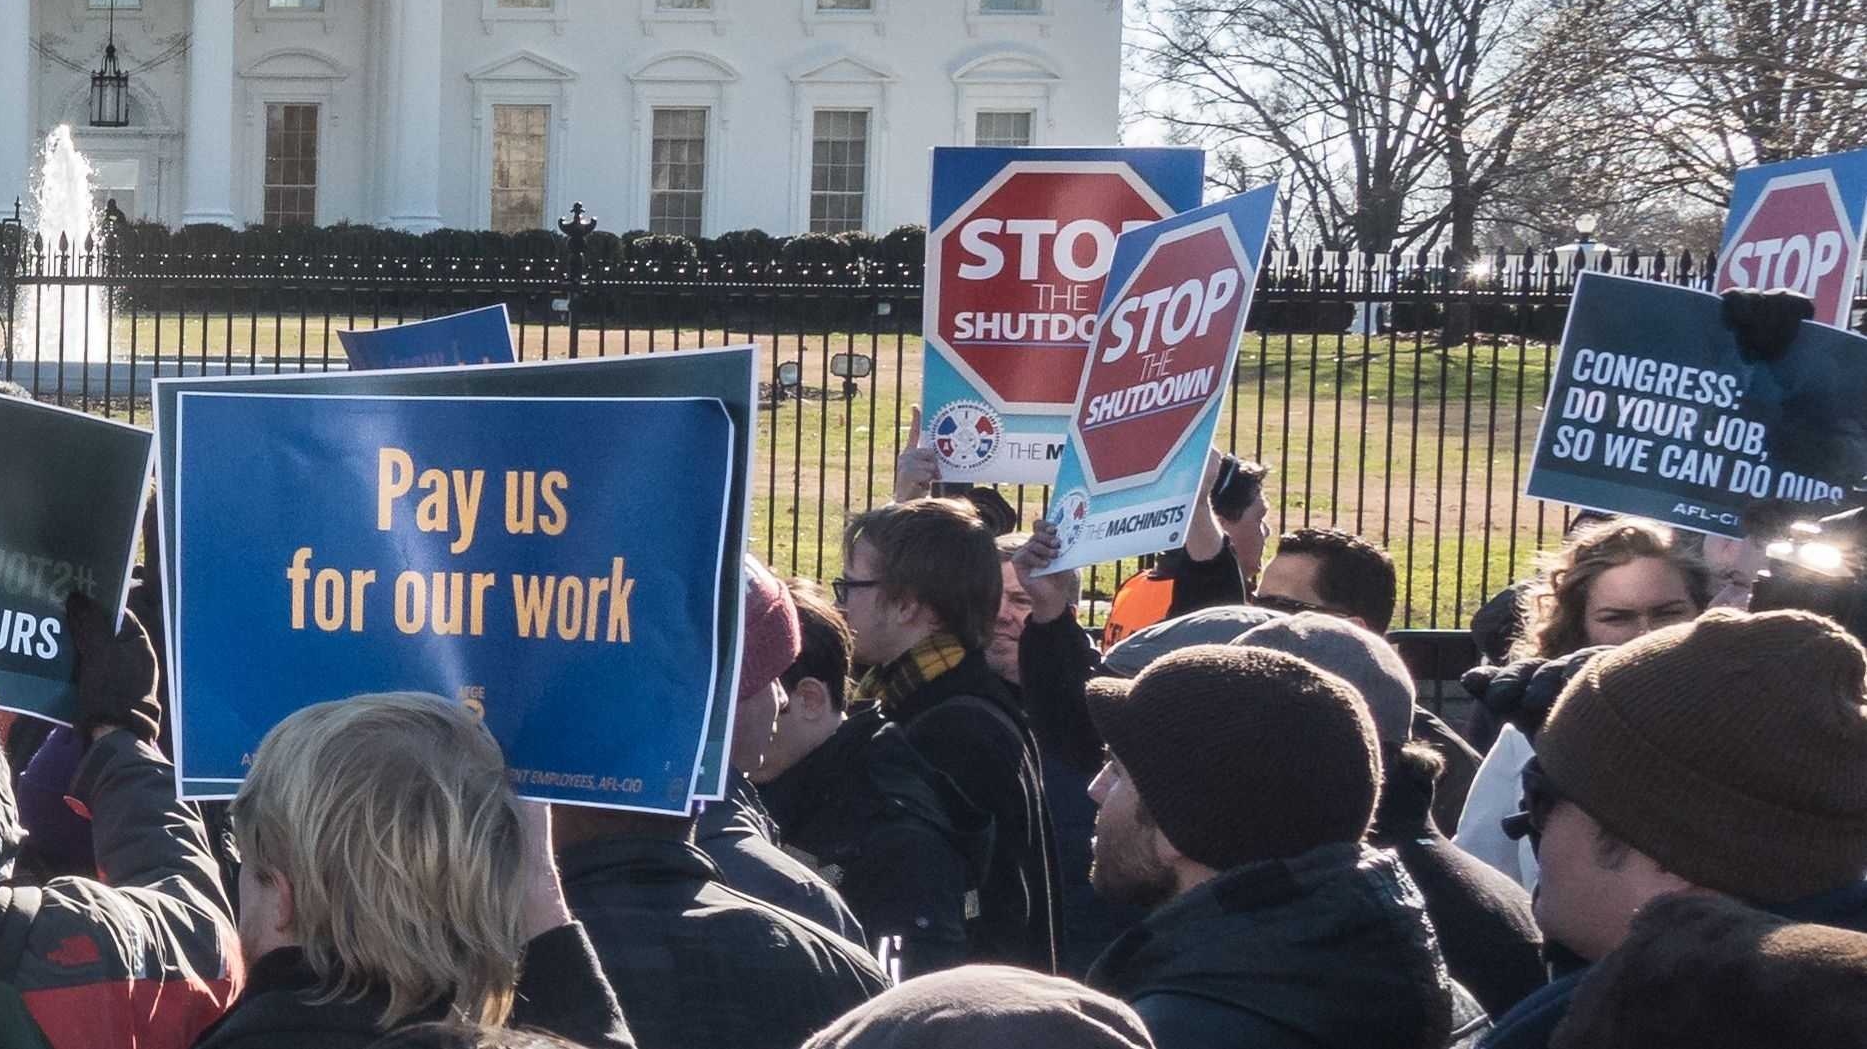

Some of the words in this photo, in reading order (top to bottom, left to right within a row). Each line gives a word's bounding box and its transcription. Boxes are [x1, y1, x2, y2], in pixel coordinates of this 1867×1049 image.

[957, 218, 1163, 283] STO
[1730, 230, 1843, 298] STOP
[953, 312, 1097, 342] SHUTDO
[1032, 283, 1089, 311] THE
[1102, 268, 1238, 364] STOP
[1085, 366, 1214, 426] SHUTDOWN
[1140, 349, 1174, 382] THE
[1572, 348, 1743, 411] CONGRESS:
[1007, 442, 1041, 460] THE
[1562, 388, 1607, 424] DO
[1616, 395, 1697, 442] YOUR
[1704, 414, 1769, 462] JOB,
[1552, 426, 1595, 463] SO
[1603, 433, 1654, 473] WE
[1658, 445, 1723, 489] CAN
[1729, 460, 1771, 498] DO
[377, 447, 484, 555] Pay
[505, 470, 569, 536] us
[1085, 522, 1107, 540] THE
[1106, 505, 1186, 538] MACHINISTS
[287, 547, 376, 633] for
[394, 570, 494, 636] our
[512, 557, 636, 643] work
[532, 770, 594, 790] EMPLOYEES,
[598, 775, 643, 793] AFL-CIO
